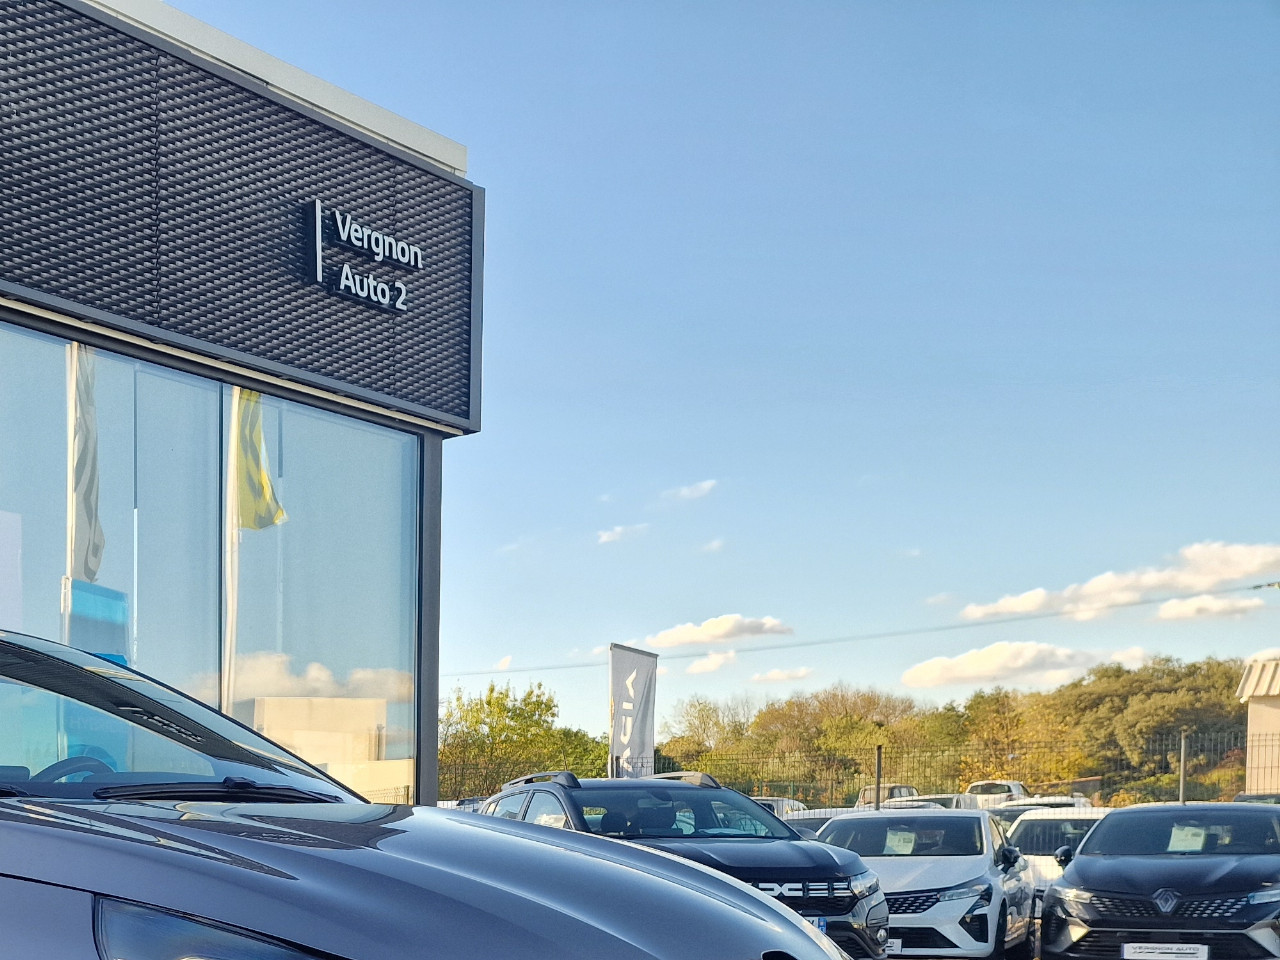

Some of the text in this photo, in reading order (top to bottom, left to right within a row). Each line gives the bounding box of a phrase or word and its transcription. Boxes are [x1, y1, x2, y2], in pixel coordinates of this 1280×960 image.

[334, 209, 423, 269] Vergnon
[340, 264, 408, 311] Auto 2
